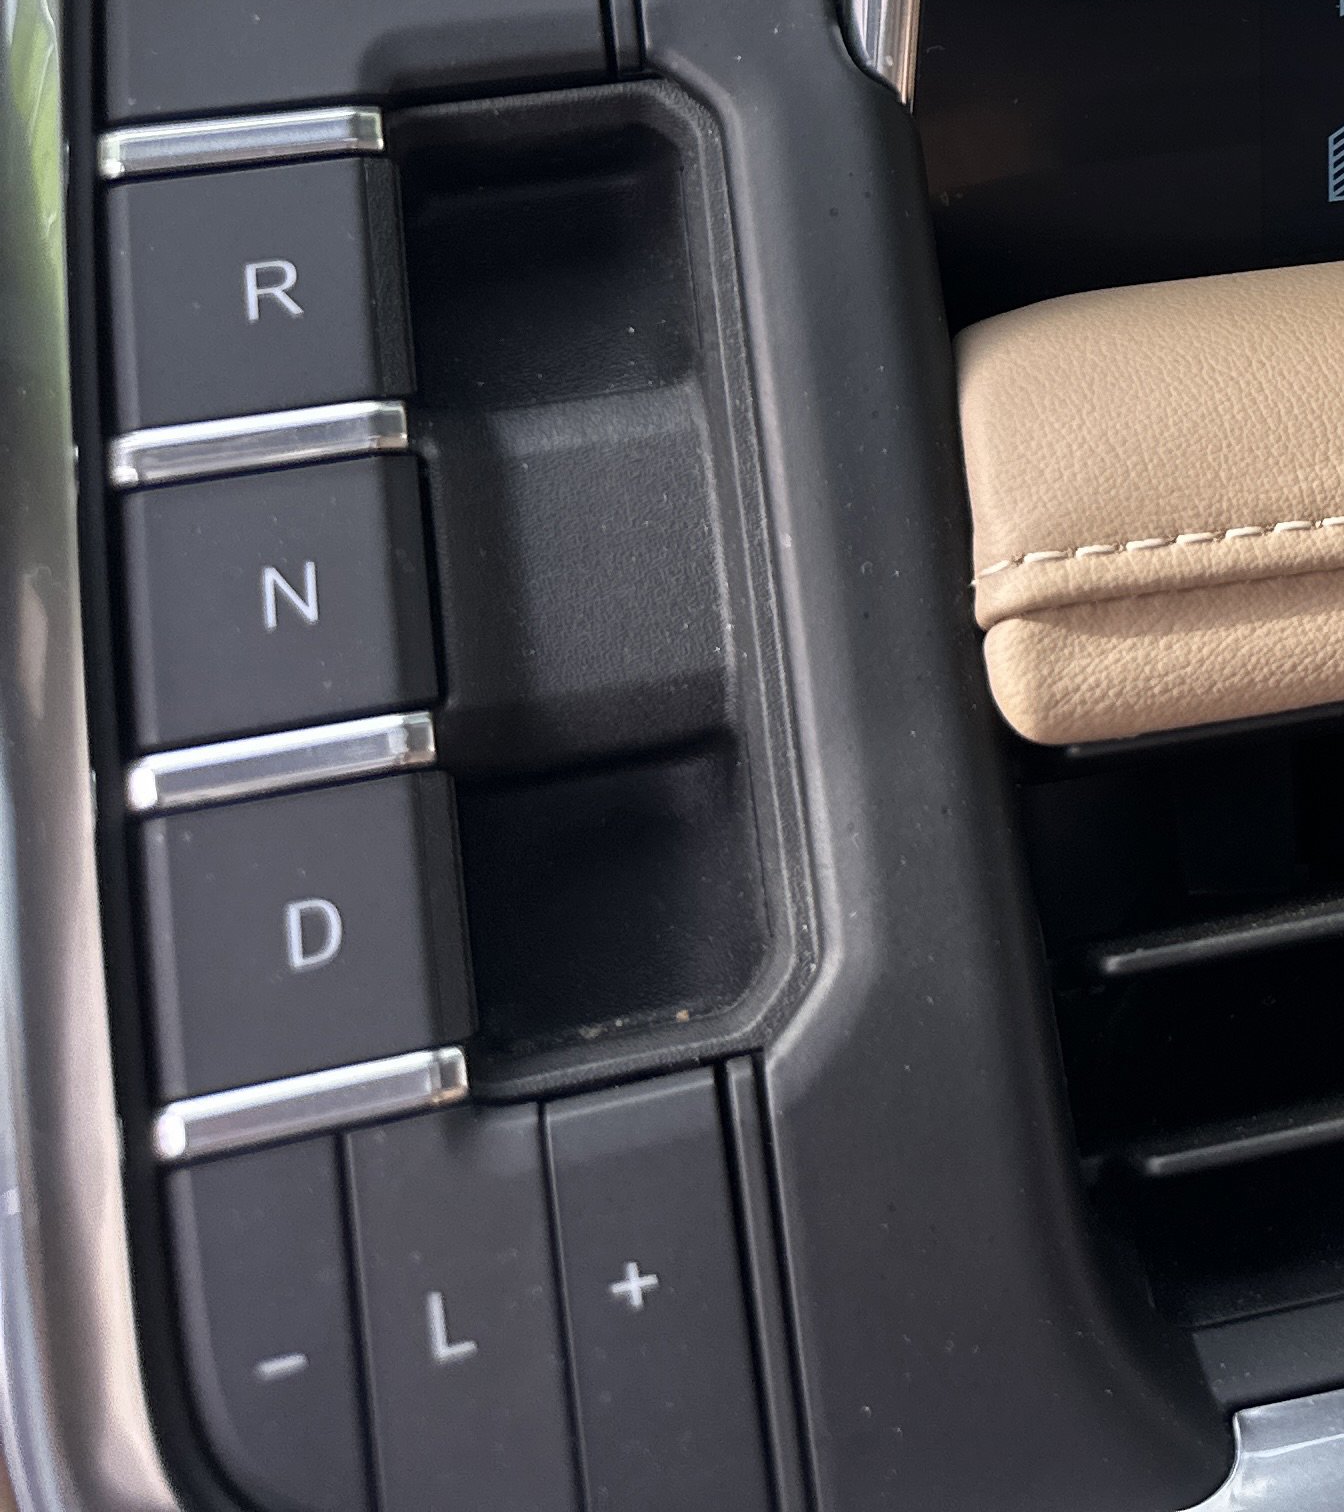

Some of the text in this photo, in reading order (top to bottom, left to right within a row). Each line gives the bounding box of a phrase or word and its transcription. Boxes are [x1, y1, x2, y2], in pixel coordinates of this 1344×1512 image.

[243, 259, 304, 323] R
[261, 561, 320, 630] N
[285, 898, 343, 970] D
[426, 1291, 478, 1364] L
